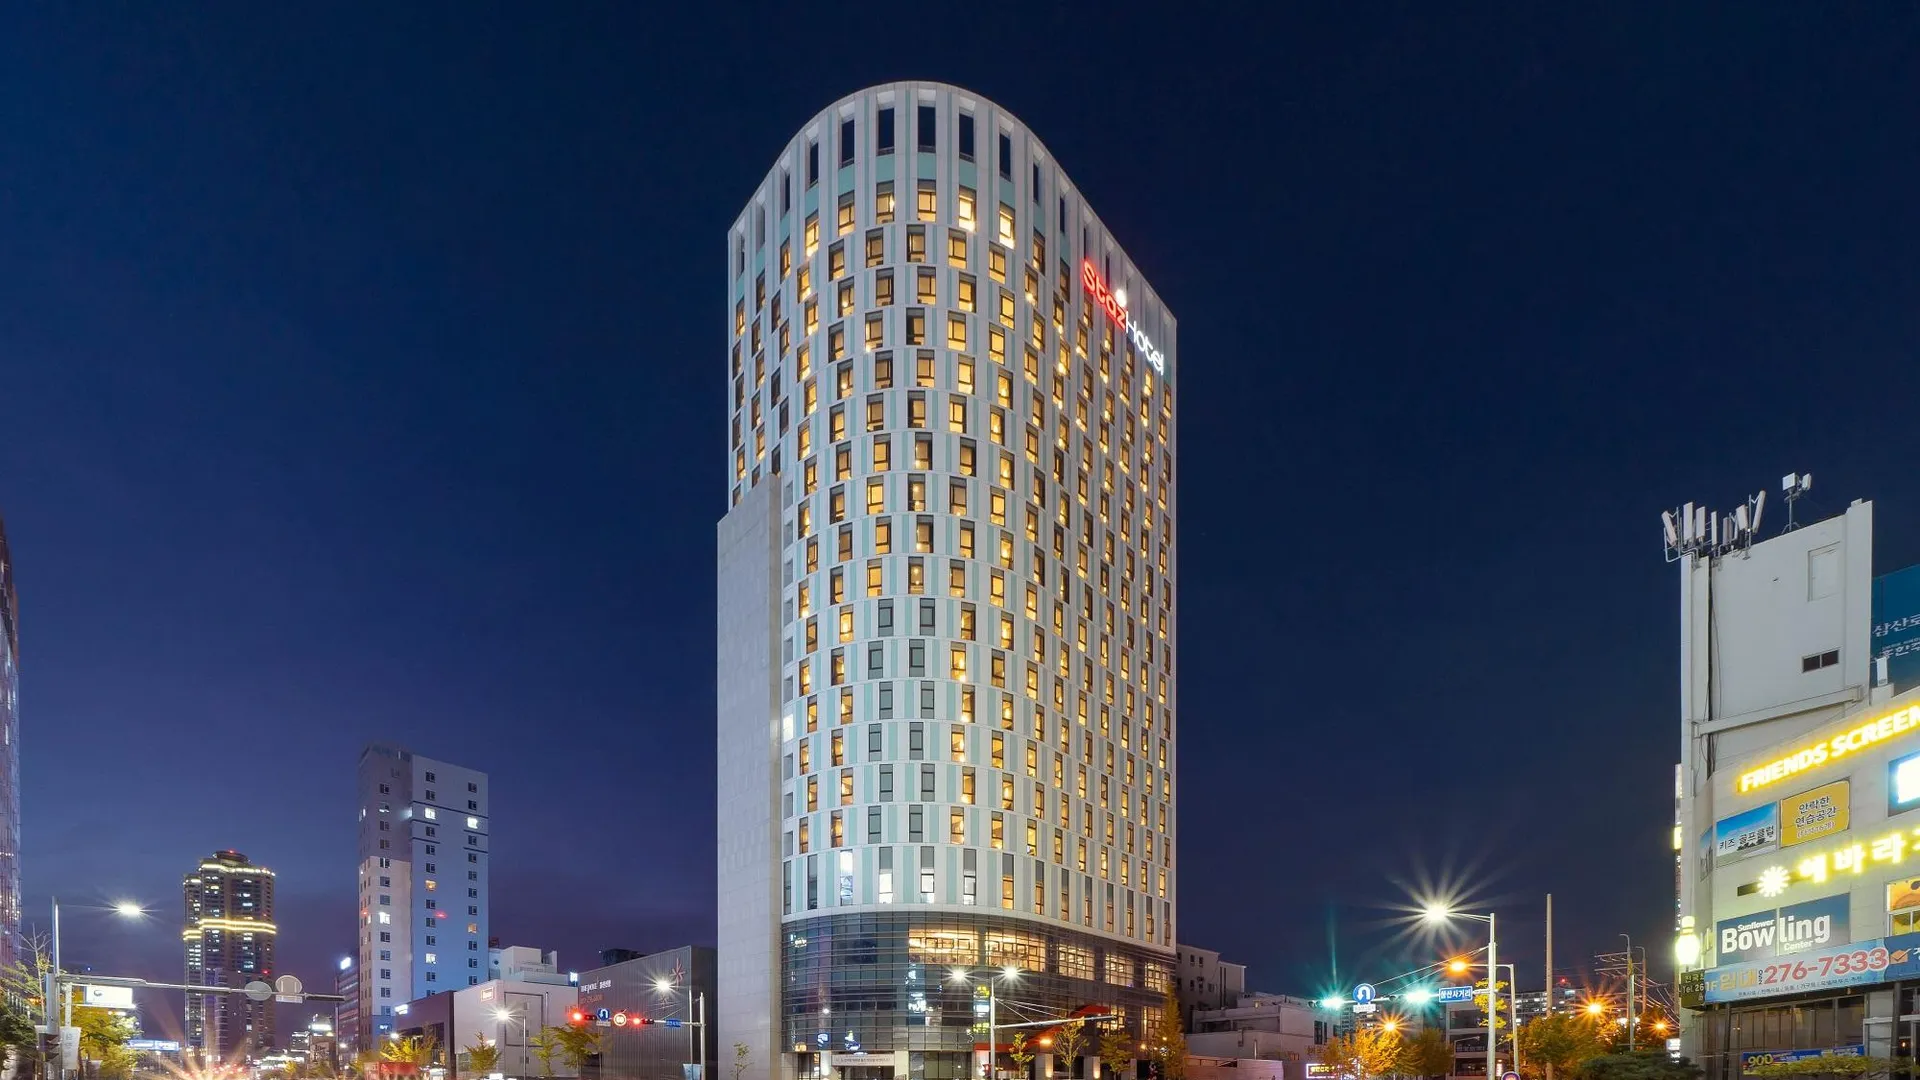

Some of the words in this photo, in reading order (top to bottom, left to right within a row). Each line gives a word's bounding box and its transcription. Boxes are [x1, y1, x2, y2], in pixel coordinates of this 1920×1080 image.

[1083, 260, 1126, 331] Staz
[1125, 311, 1164, 376] Hotel
[1741, 742, 1829, 793] FRIENDS
[1798, 795, 1830, 814] 안락한
[1795, 807, 1837, 828] 연습공간
[1719, 837, 1735, 850] 키즈
[1738, 825, 1775, 846] 골프클럽
[1737, 919, 1775, 932] Sunflower
[1784, 939, 1814, 951] Center
[1764, 946, 1889, 986] 276-7333
